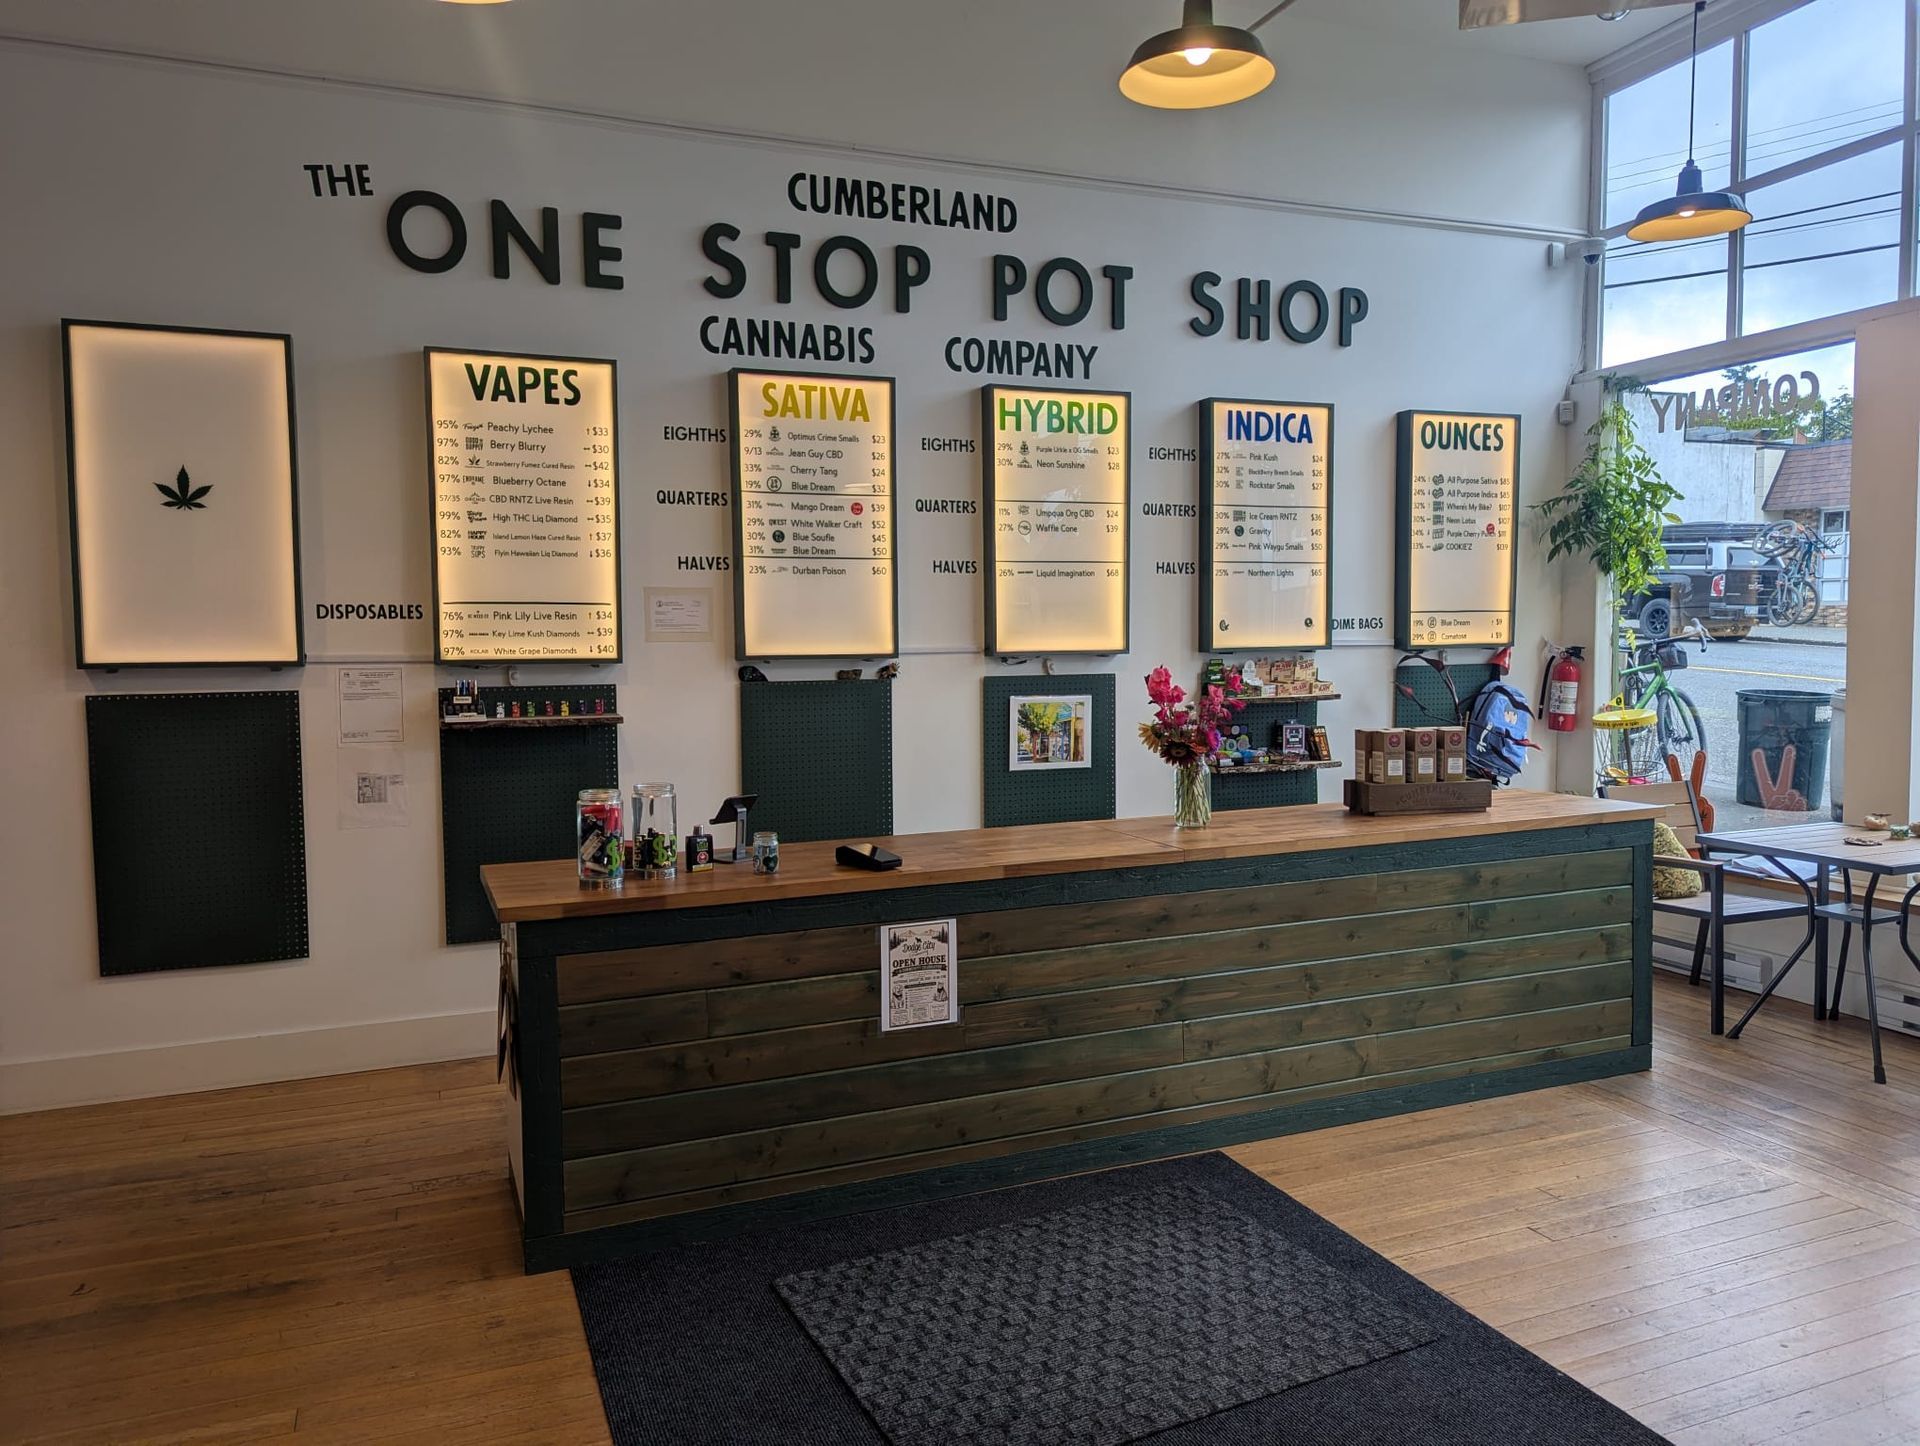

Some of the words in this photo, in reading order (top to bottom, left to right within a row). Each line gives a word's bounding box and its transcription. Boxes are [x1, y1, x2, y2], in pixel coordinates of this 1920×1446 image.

[303, 164, 373, 196] THE
[787, 173, 1017, 233] CUMBERLAND
[387, 190, 624, 290] ONE
[701, 222, 931, 313] STOP
[993, 254, 1133, 330] POT
[1190, 270, 1369, 347] SHOP
[700, 315, 875, 364] CANNABIS
[944, 336, 1098, 380] COMPANY
[464, 363, 581, 406] VAPES
[762, 382, 870, 422] SATIVA
[999, 398, 1118, 434] HYBRID
[437, 420, 458, 429] 95%
[488, 422, 519, 434] Peachy
[523, 424, 553, 434] Lychee
[592, 427, 608, 436] $33
[1228, 410, 1312, 443] INDICA
[664, 426, 726, 443] EIGHTHS
[788, 433, 815, 441] Optimus
[818, 433, 837, 442] Crime
[839, 434, 859, 442] Smalls
[872, 436, 885, 444] $23
[1421, 421, 1504, 451] OUNCES
[437, 438, 458, 448] 97%
[491, 440, 515, 451] Berry
[518, 442, 546, 453] Blurry
[592, 445, 609, 453] $30
[921, 438, 975, 453] EIGHTHS
[808, 450, 823, 459] Guy
[826, 451, 843, 459] CBD
[872, 452, 885, 460] $26
[1149, 447, 1196, 461] EIGHTHS
[438, 456, 459, 465] 82%
[487, 460, 520, 469] Strawberry
[593, 462, 609, 470] $42
[1037, 460, 1054, 468] Neon
[1108, 462, 1120, 470] $28
[790, 466, 817, 476] Cherry
[820, 467, 837, 477] Tang
[872, 468, 885, 476] $24
[439, 475, 460, 483] 97%
[493, 476, 533, 487] Blueberry
[537, 478, 566, 487] Octane
[594, 480, 609, 488] $34
[1249, 481, 1274, 489] Rockstar
[1457, 476, 1478, 485] Purpose
[792, 482, 808, 490] Blue
[811, 483, 835, 491] Dream
[872, 485, 885, 493] $32
[489, 495, 507, 503] CBD
[510, 496, 533, 504] RNTZ
[536, 496, 551, 504] Live
[554, 497, 573, 505] Resin
[594, 497, 610, 505] $39
[656, 490, 728, 506] QUARTERS
[1457, 491, 1480, 499] Purpose
[791, 502, 817, 512] Mango
[820, 503, 844, 511] Dream
[871, 504, 885, 512] $39
[916, 499, 976, 514] QUARTERS
[1143, 503, 1196, 517] QUARTERS
[439, 512, 460, 520] 99%
[493, 514, 510, 523] High
[546, 515, 577, 523] Diamond
[595, 515, 611, 524] $35
[1080, 510, 1094, 518] CBD
[440, 530, 461, 538] 82%
[597, 533, 611, 541] $37
[792, 533, 809, 541] Blue
[872, 534, 886, 542] $45
[440, 548, 462, 556] 93%
[595, 549, 611, 558] $36
[812, 547, 836, 555] Dream
[872, 548, 887, 556] $50
[1249, 542, 1260, 550] Pink
[1263, 543, 1284, 552] Waygu
[678, 556, 729, 570] HALVES
[933, 560, 977, 574] HALVES
[1156, 562, 1195, 574] HALVES
[793, 566, 820, 575] Durban
[822, 567, 846, 575] Poison
[872, 567, 886, 575] $60
[1058, 570, 1095, 578] Imagination
[316, 604, 423, 619] DISPOSABLES
[443, 612, 463, 620] 76%
[494, 611, 512, 620] Pink
[516, 612, 531, 621] Lily
[596, 611, 612, 619] $34
[1333, 619, 1356, 630] DIME
[1359, 617, 1383, 629] BAGS
[443, 630, 464, 638] 97%
[597, 628, 613, 637] $39
[443, 647, 465, 656] 97%
[519, 648, 540, 656] Grape
[597, 645, 614, 653] $40
[893, 959, 915, 968] OPEN
[919, 955, 946, 965] HOUSE
